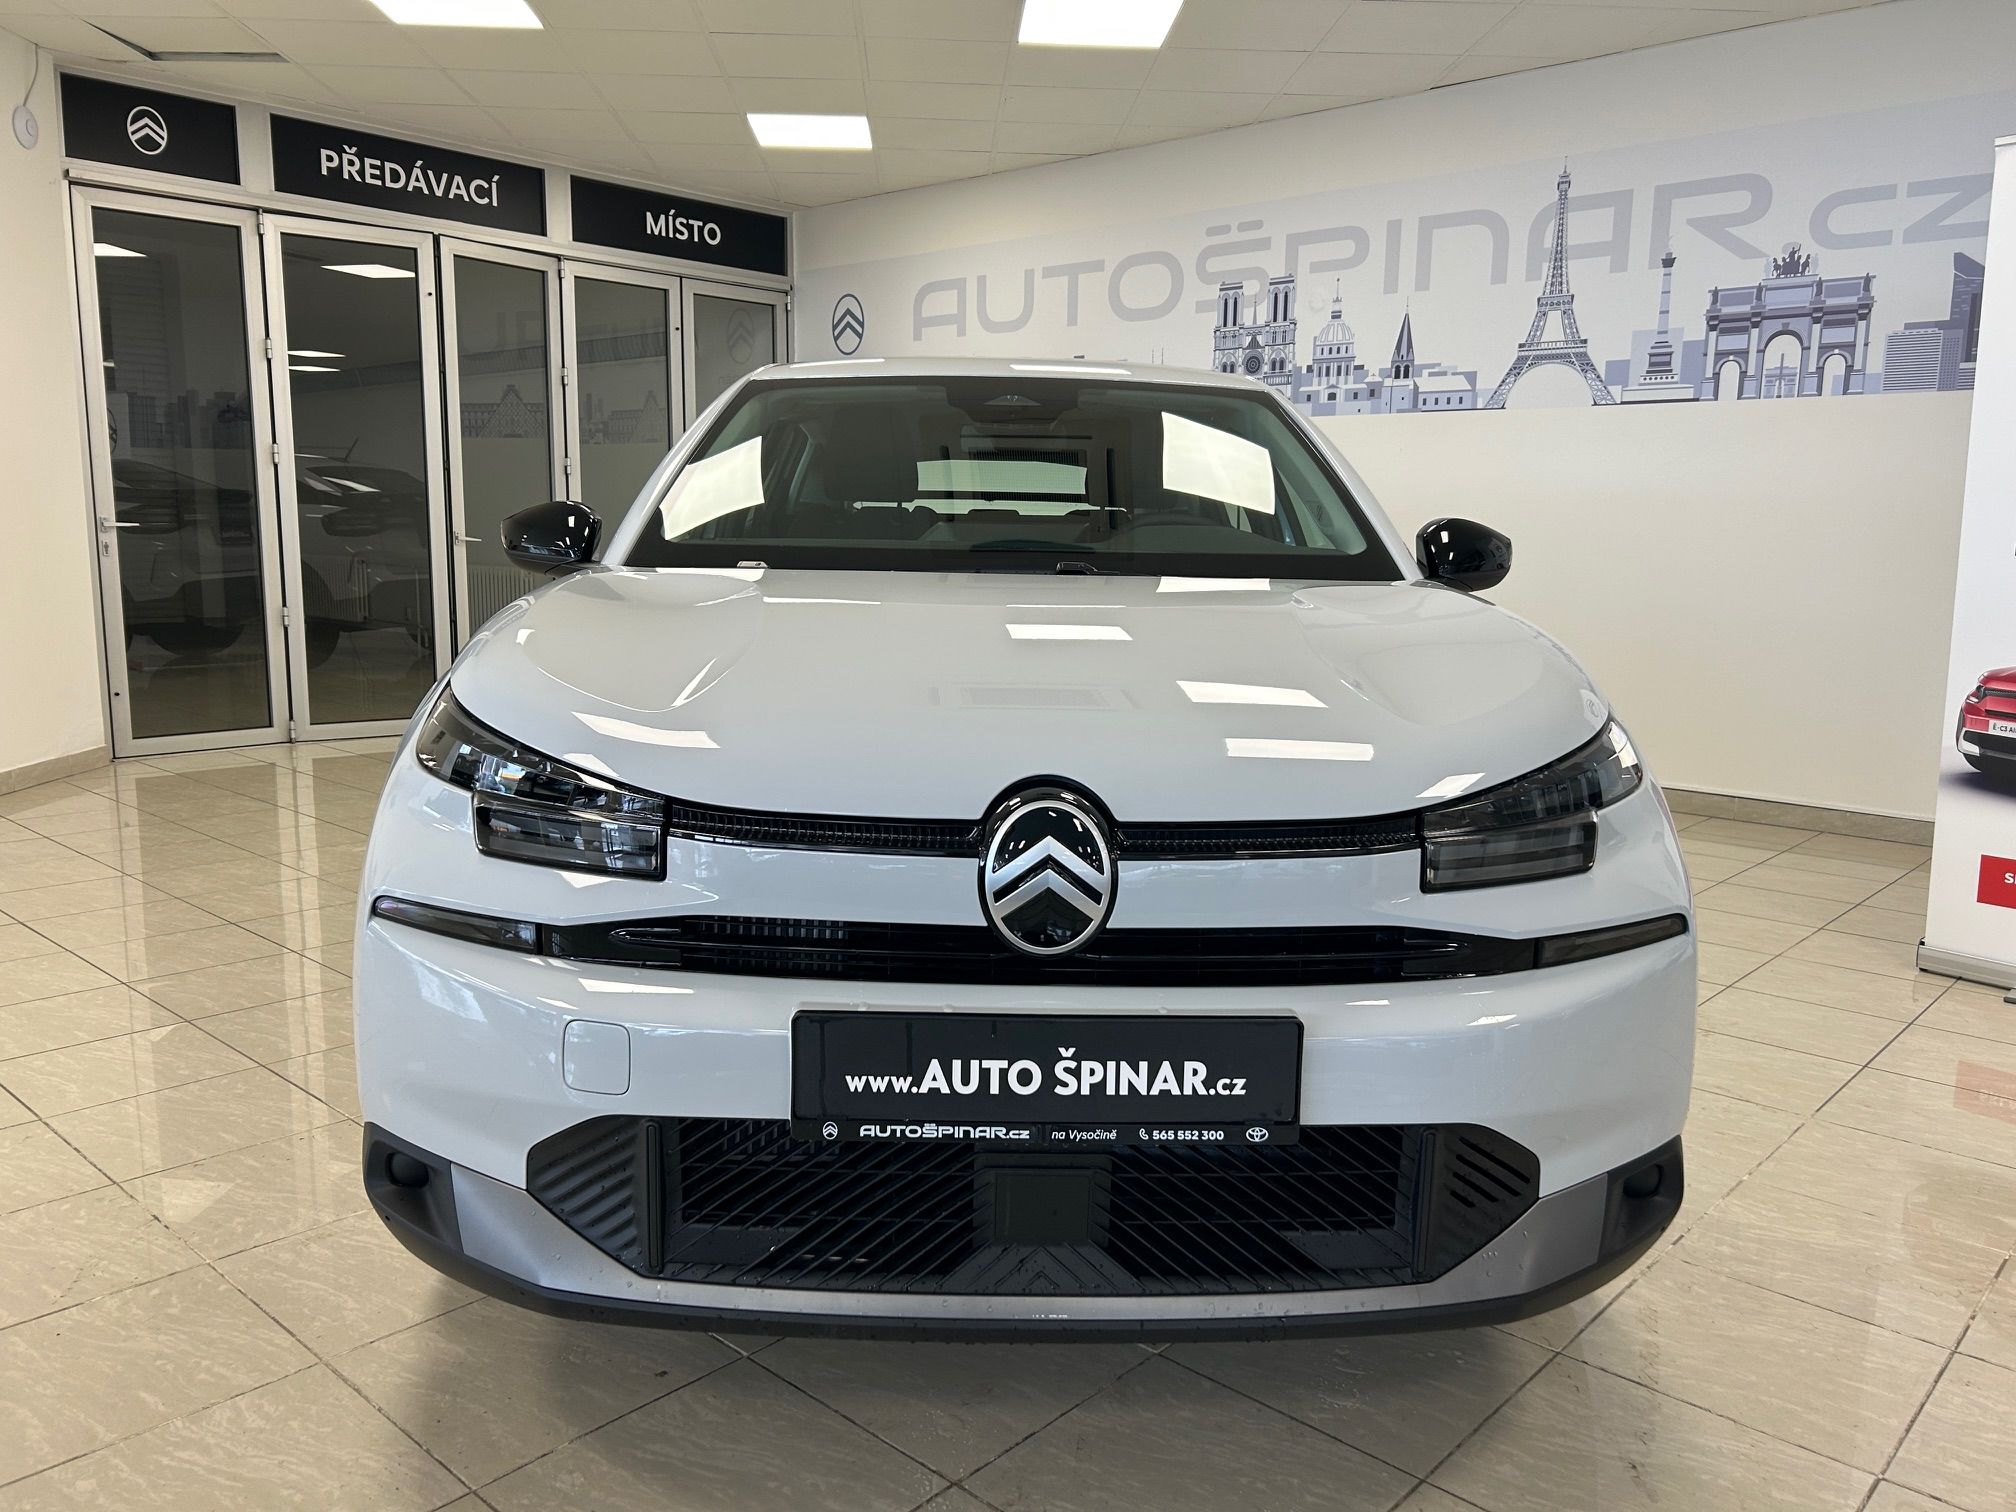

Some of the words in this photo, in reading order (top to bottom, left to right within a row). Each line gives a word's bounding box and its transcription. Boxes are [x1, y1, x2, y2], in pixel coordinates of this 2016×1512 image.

[320, 144, 500, 207] PŘEDÁVACÍ
[645, 209, 722, 246] MÍSTO
[845, 1058, 1042, 1096] www.AUTO
[1053, 1047, 1247, 1097] ŠPINAR.cz
[1051, 1130, 1066, 1140] na
[1068, 1128, 1118, 1142] Vysočině
[1152, 1130, 1175, 1141] 565
[1177, 1130, 1199, 1141] 552
[1201, 1130, 1225, 1141] 300
